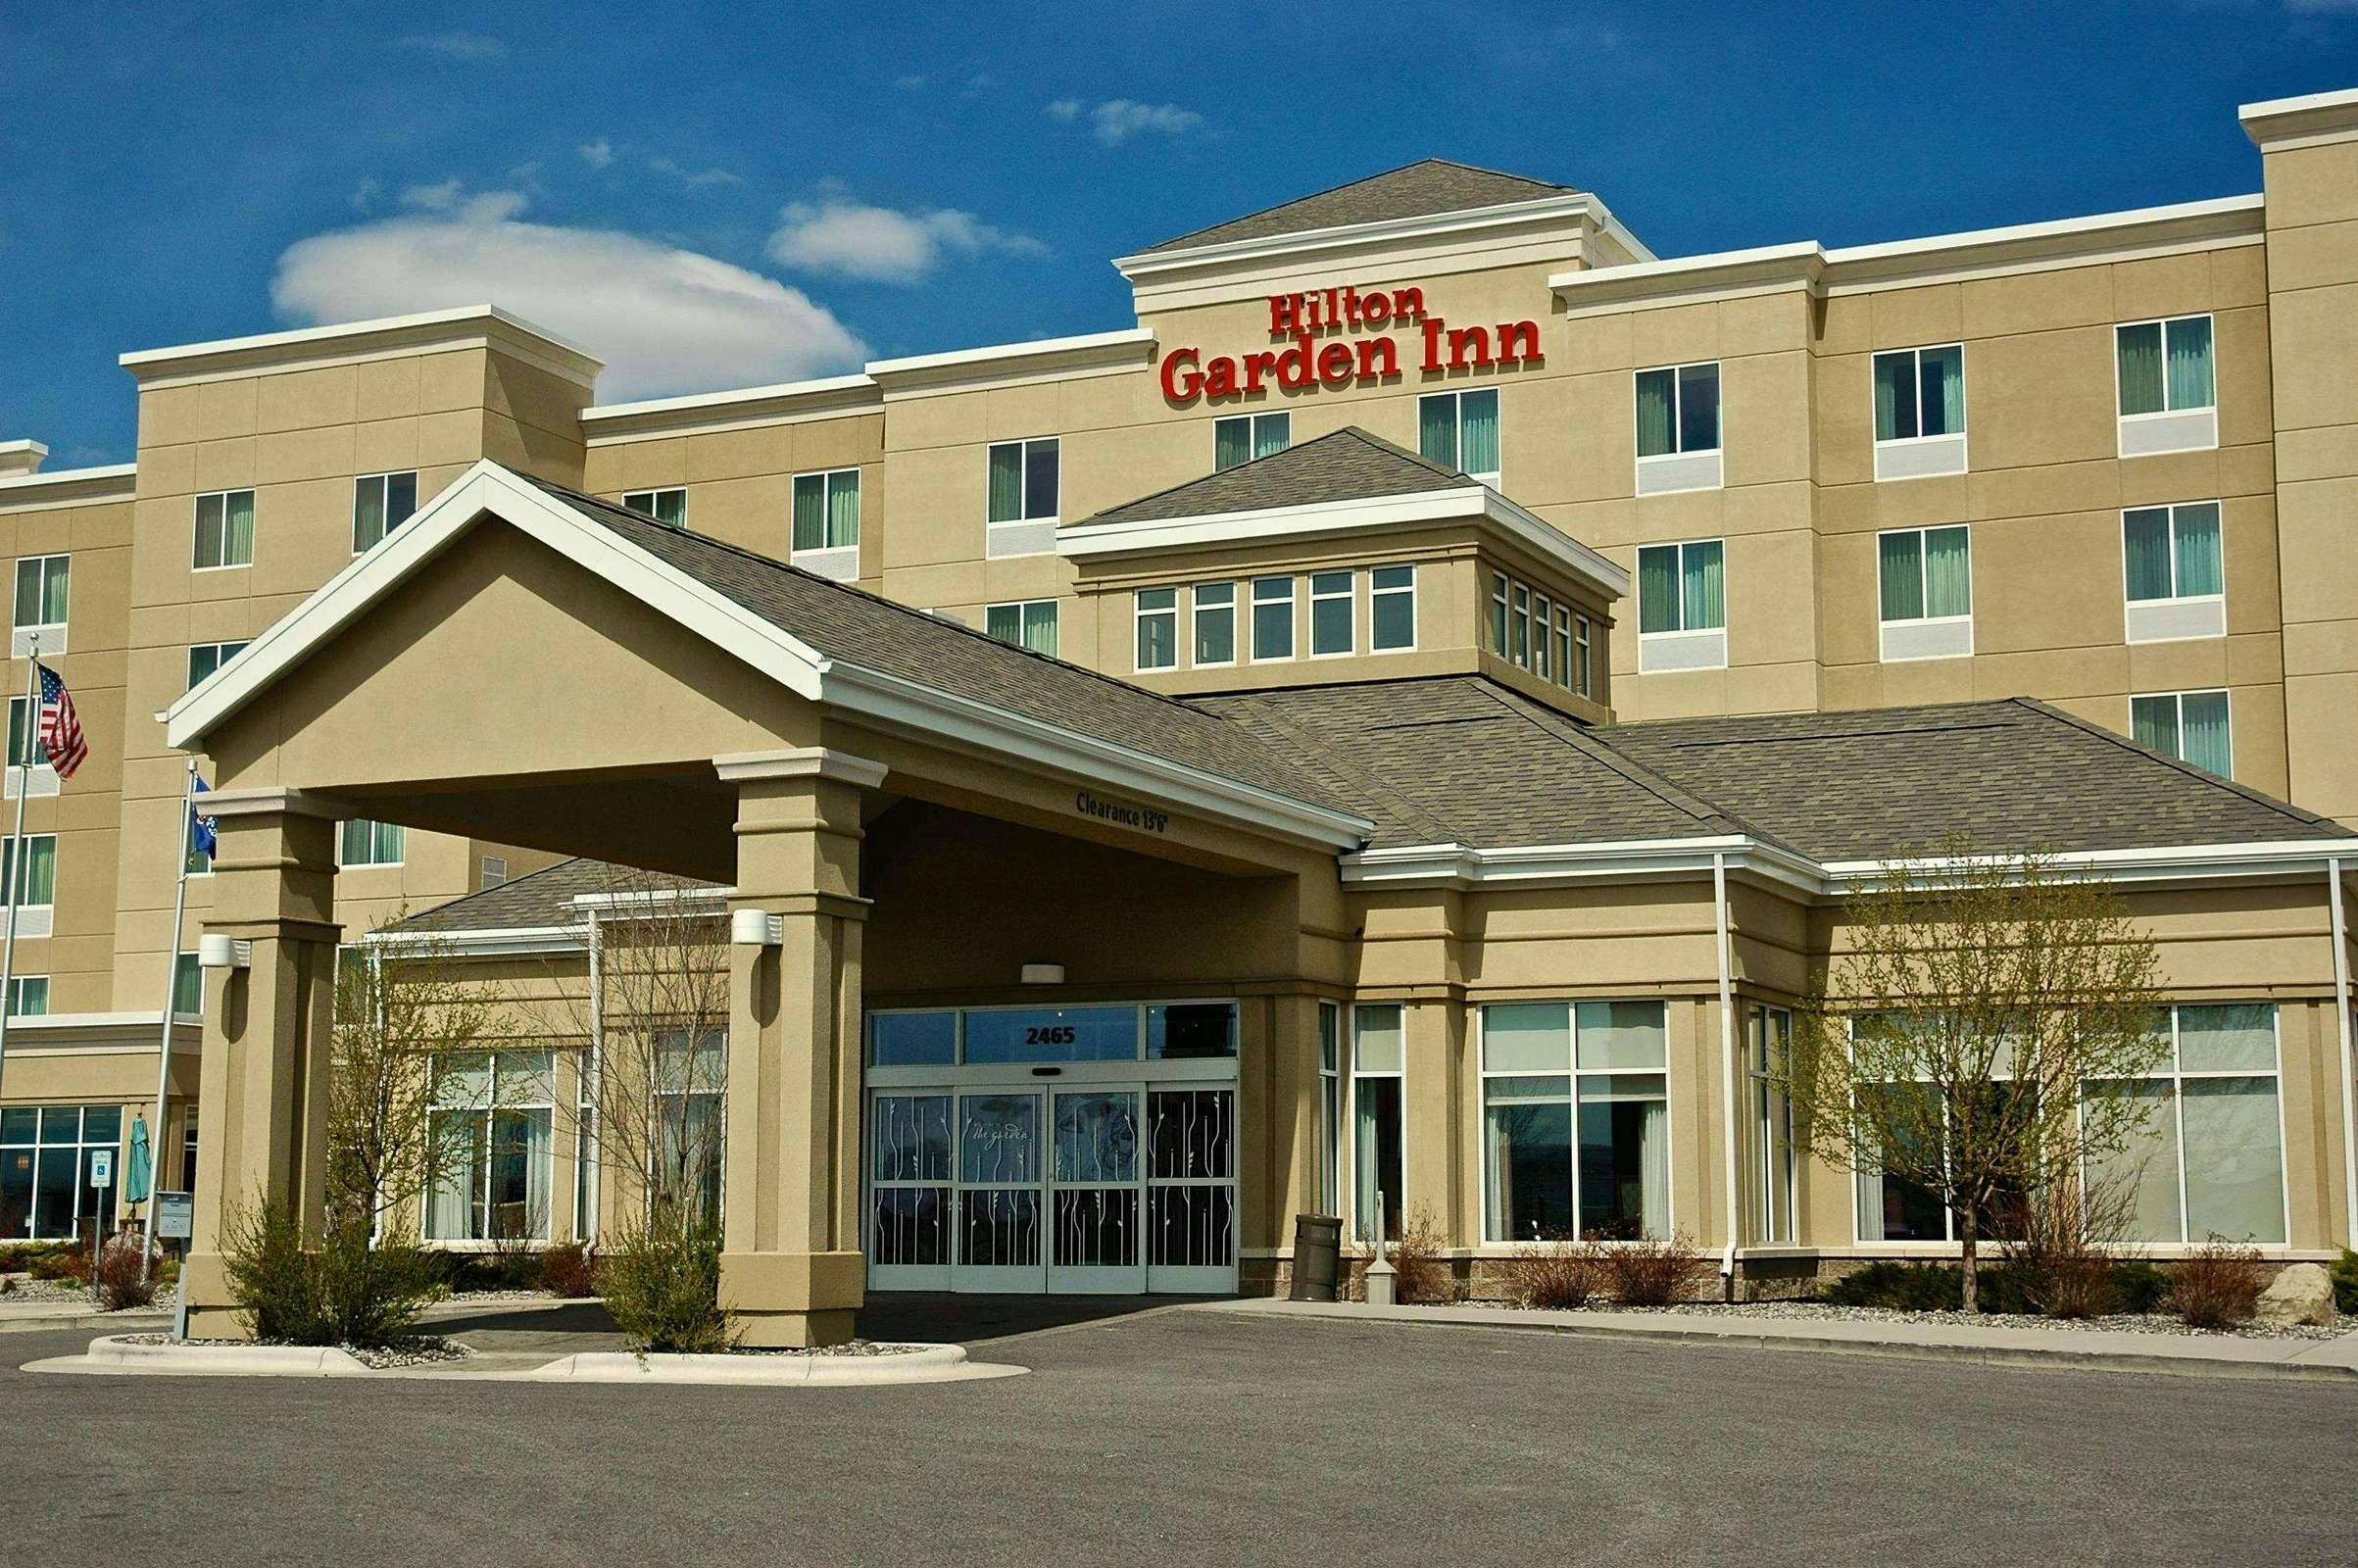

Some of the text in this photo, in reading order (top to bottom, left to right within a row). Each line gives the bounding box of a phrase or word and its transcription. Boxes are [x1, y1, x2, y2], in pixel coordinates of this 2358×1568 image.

[1268, 285, 1428, 335] Hilton
[1159, 318, 1545, 403] Garden Inn
[1076, 791, 1140, 827] Clearance
[1026, 1026, 1075, 1046] 2465
